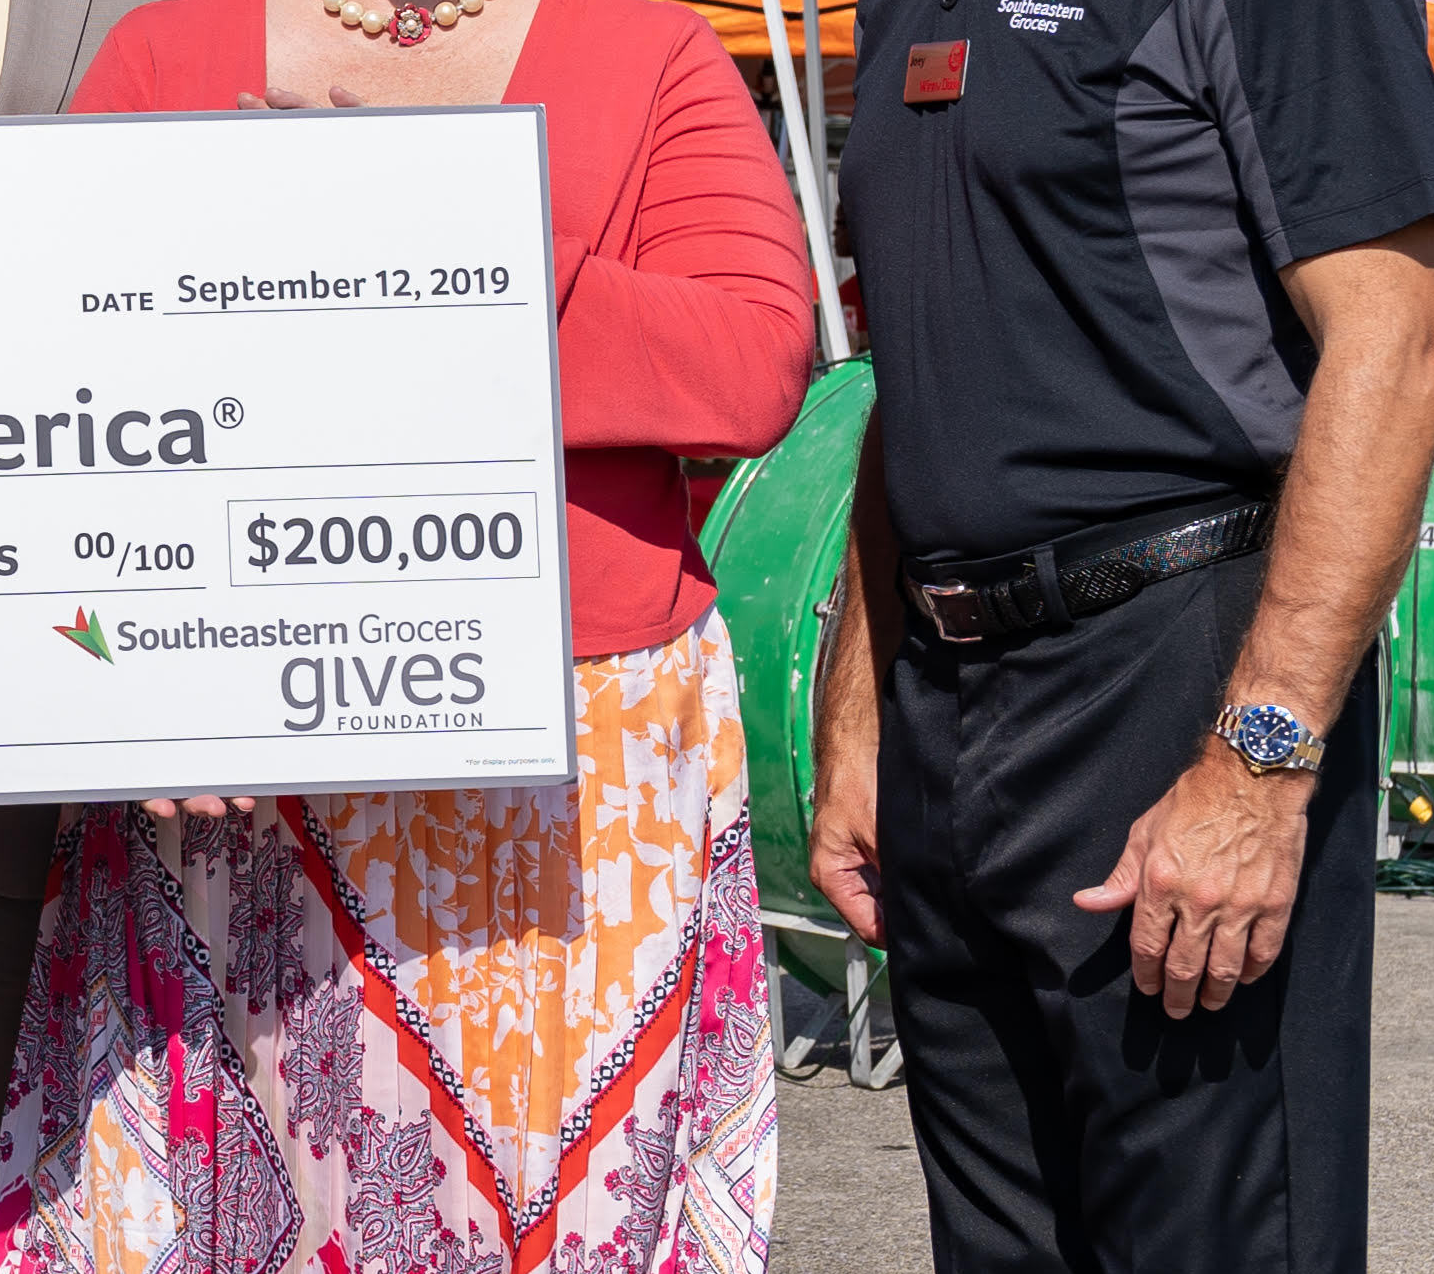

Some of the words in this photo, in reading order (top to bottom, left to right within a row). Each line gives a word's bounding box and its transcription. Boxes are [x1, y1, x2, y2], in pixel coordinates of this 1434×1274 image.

[1009, 13, 1060, 33] Grocers
[81, 292, 154, 313] DATE
[177, 270, 366, 308] September
[375, 269, 421, 302] 12,
[429, 266, 510, 296] 2019
[247, 511, 523, 573] $200,000
[117, 617, 348, 652] Southeastern
[358, 613, 482, 644] Grocers
[280, 652, 486, 732] gives
[337, 712, 484, 731] FOUNDATION
